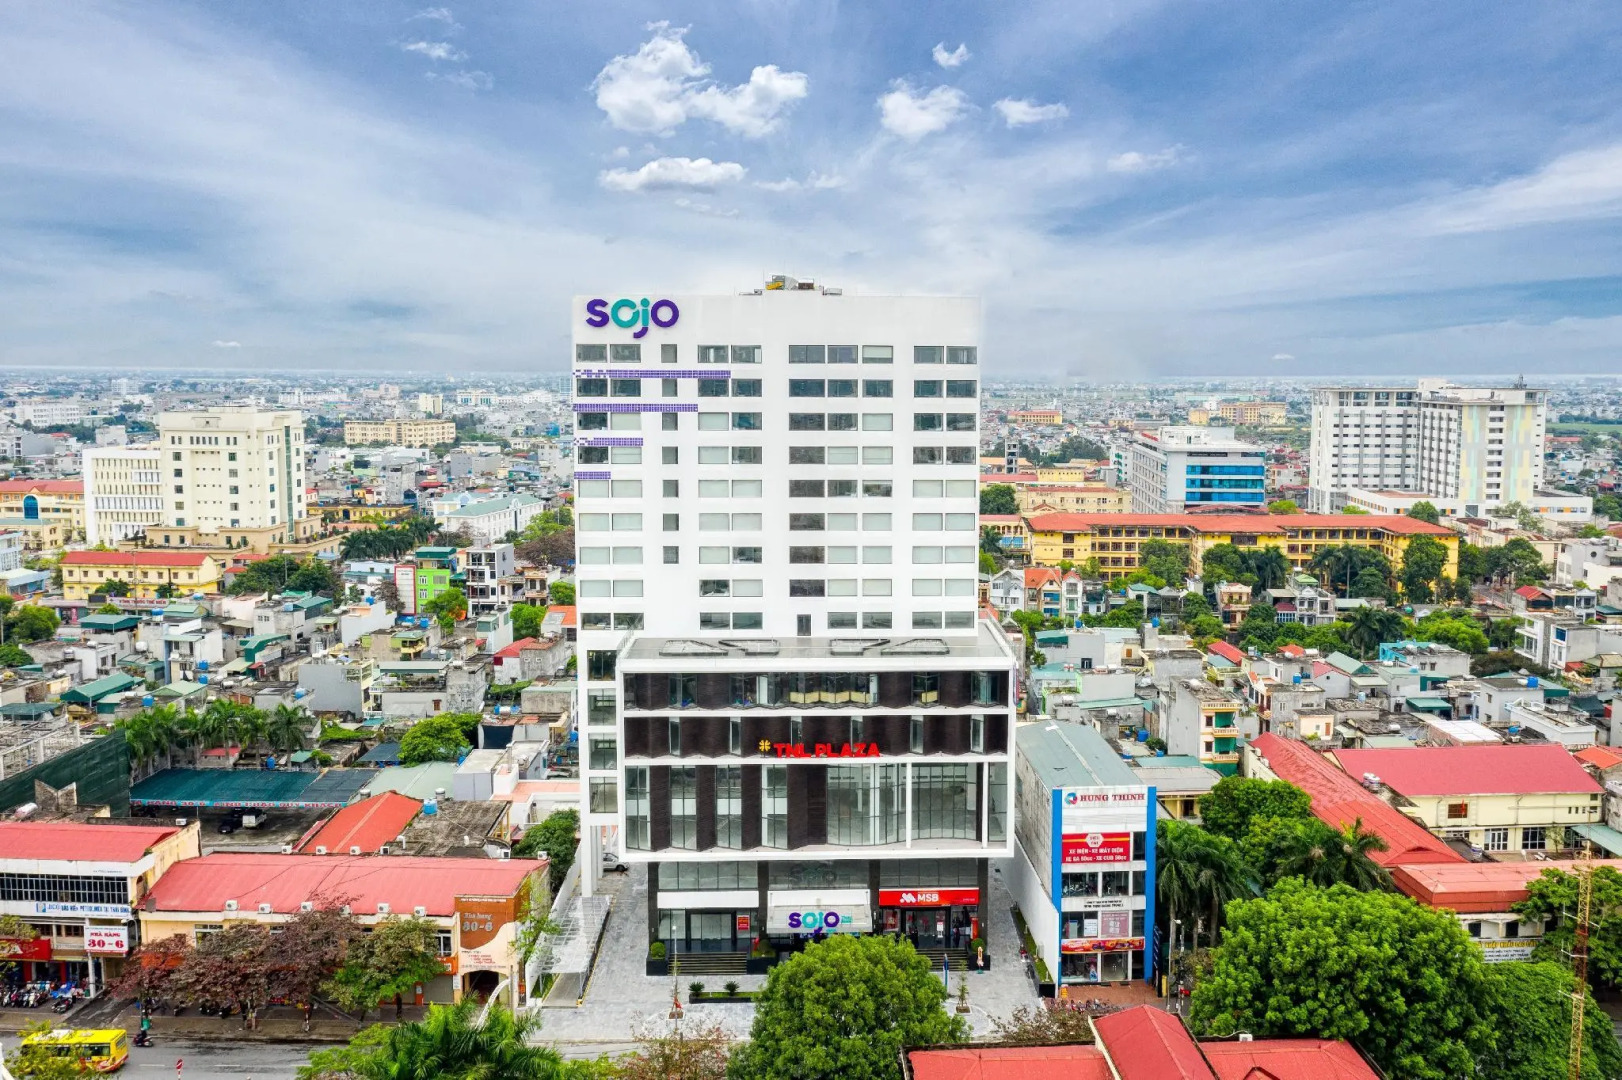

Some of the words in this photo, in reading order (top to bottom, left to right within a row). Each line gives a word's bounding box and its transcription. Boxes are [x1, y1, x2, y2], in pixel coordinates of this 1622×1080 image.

[773, 742, 812, 758] TNL
[814, 742, 880, 758] PLAZA
[917, 893, 939, 902] MSB
